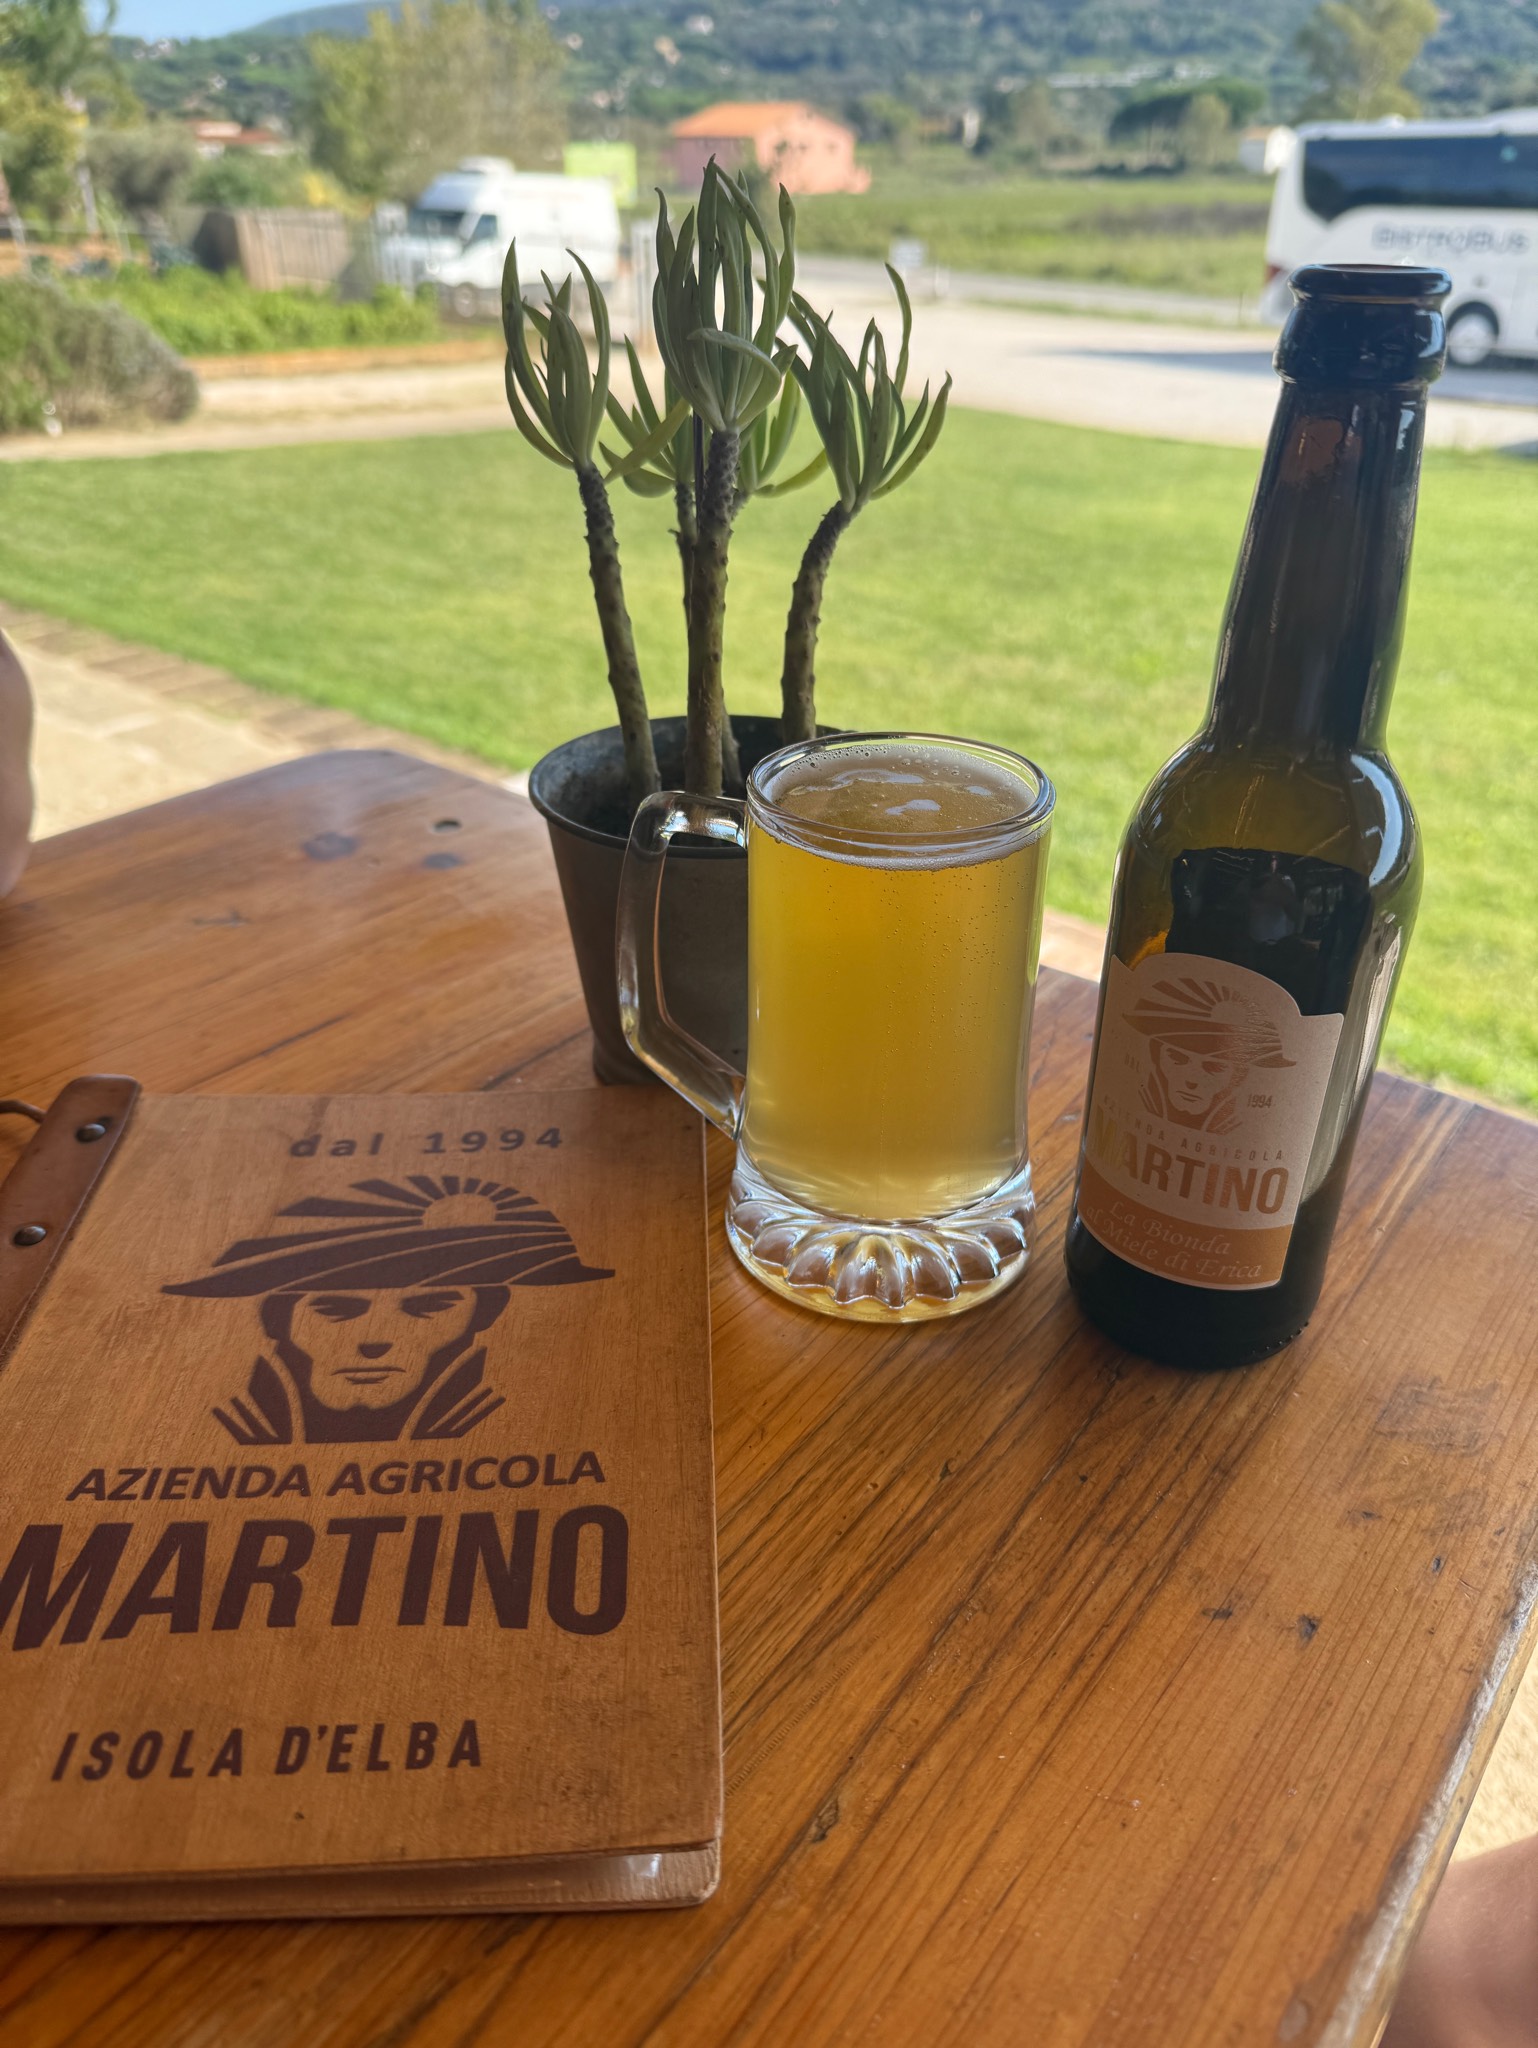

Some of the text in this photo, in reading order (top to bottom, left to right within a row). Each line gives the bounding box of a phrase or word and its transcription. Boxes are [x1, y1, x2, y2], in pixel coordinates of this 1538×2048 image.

[1247, 1093, 1273, 1109] 1994
[288, 1126, 564, 1158] dal 1994
[1094, 1102, 1290, 1215] MARTINO
[1180, 1137, 1283, 1162] AGRICOLA
[1086, 1205, 1263, 1280] al Miele di Erica
[1109, 1201, 1232, 1256] La Bionda
[65, 1450, 607, 1500] AZIENDA AGRICOLA
[0, 1504, 629, 1652] MARTINO
[50, 1719, 483, 1782] ISOLA D'ELBA
